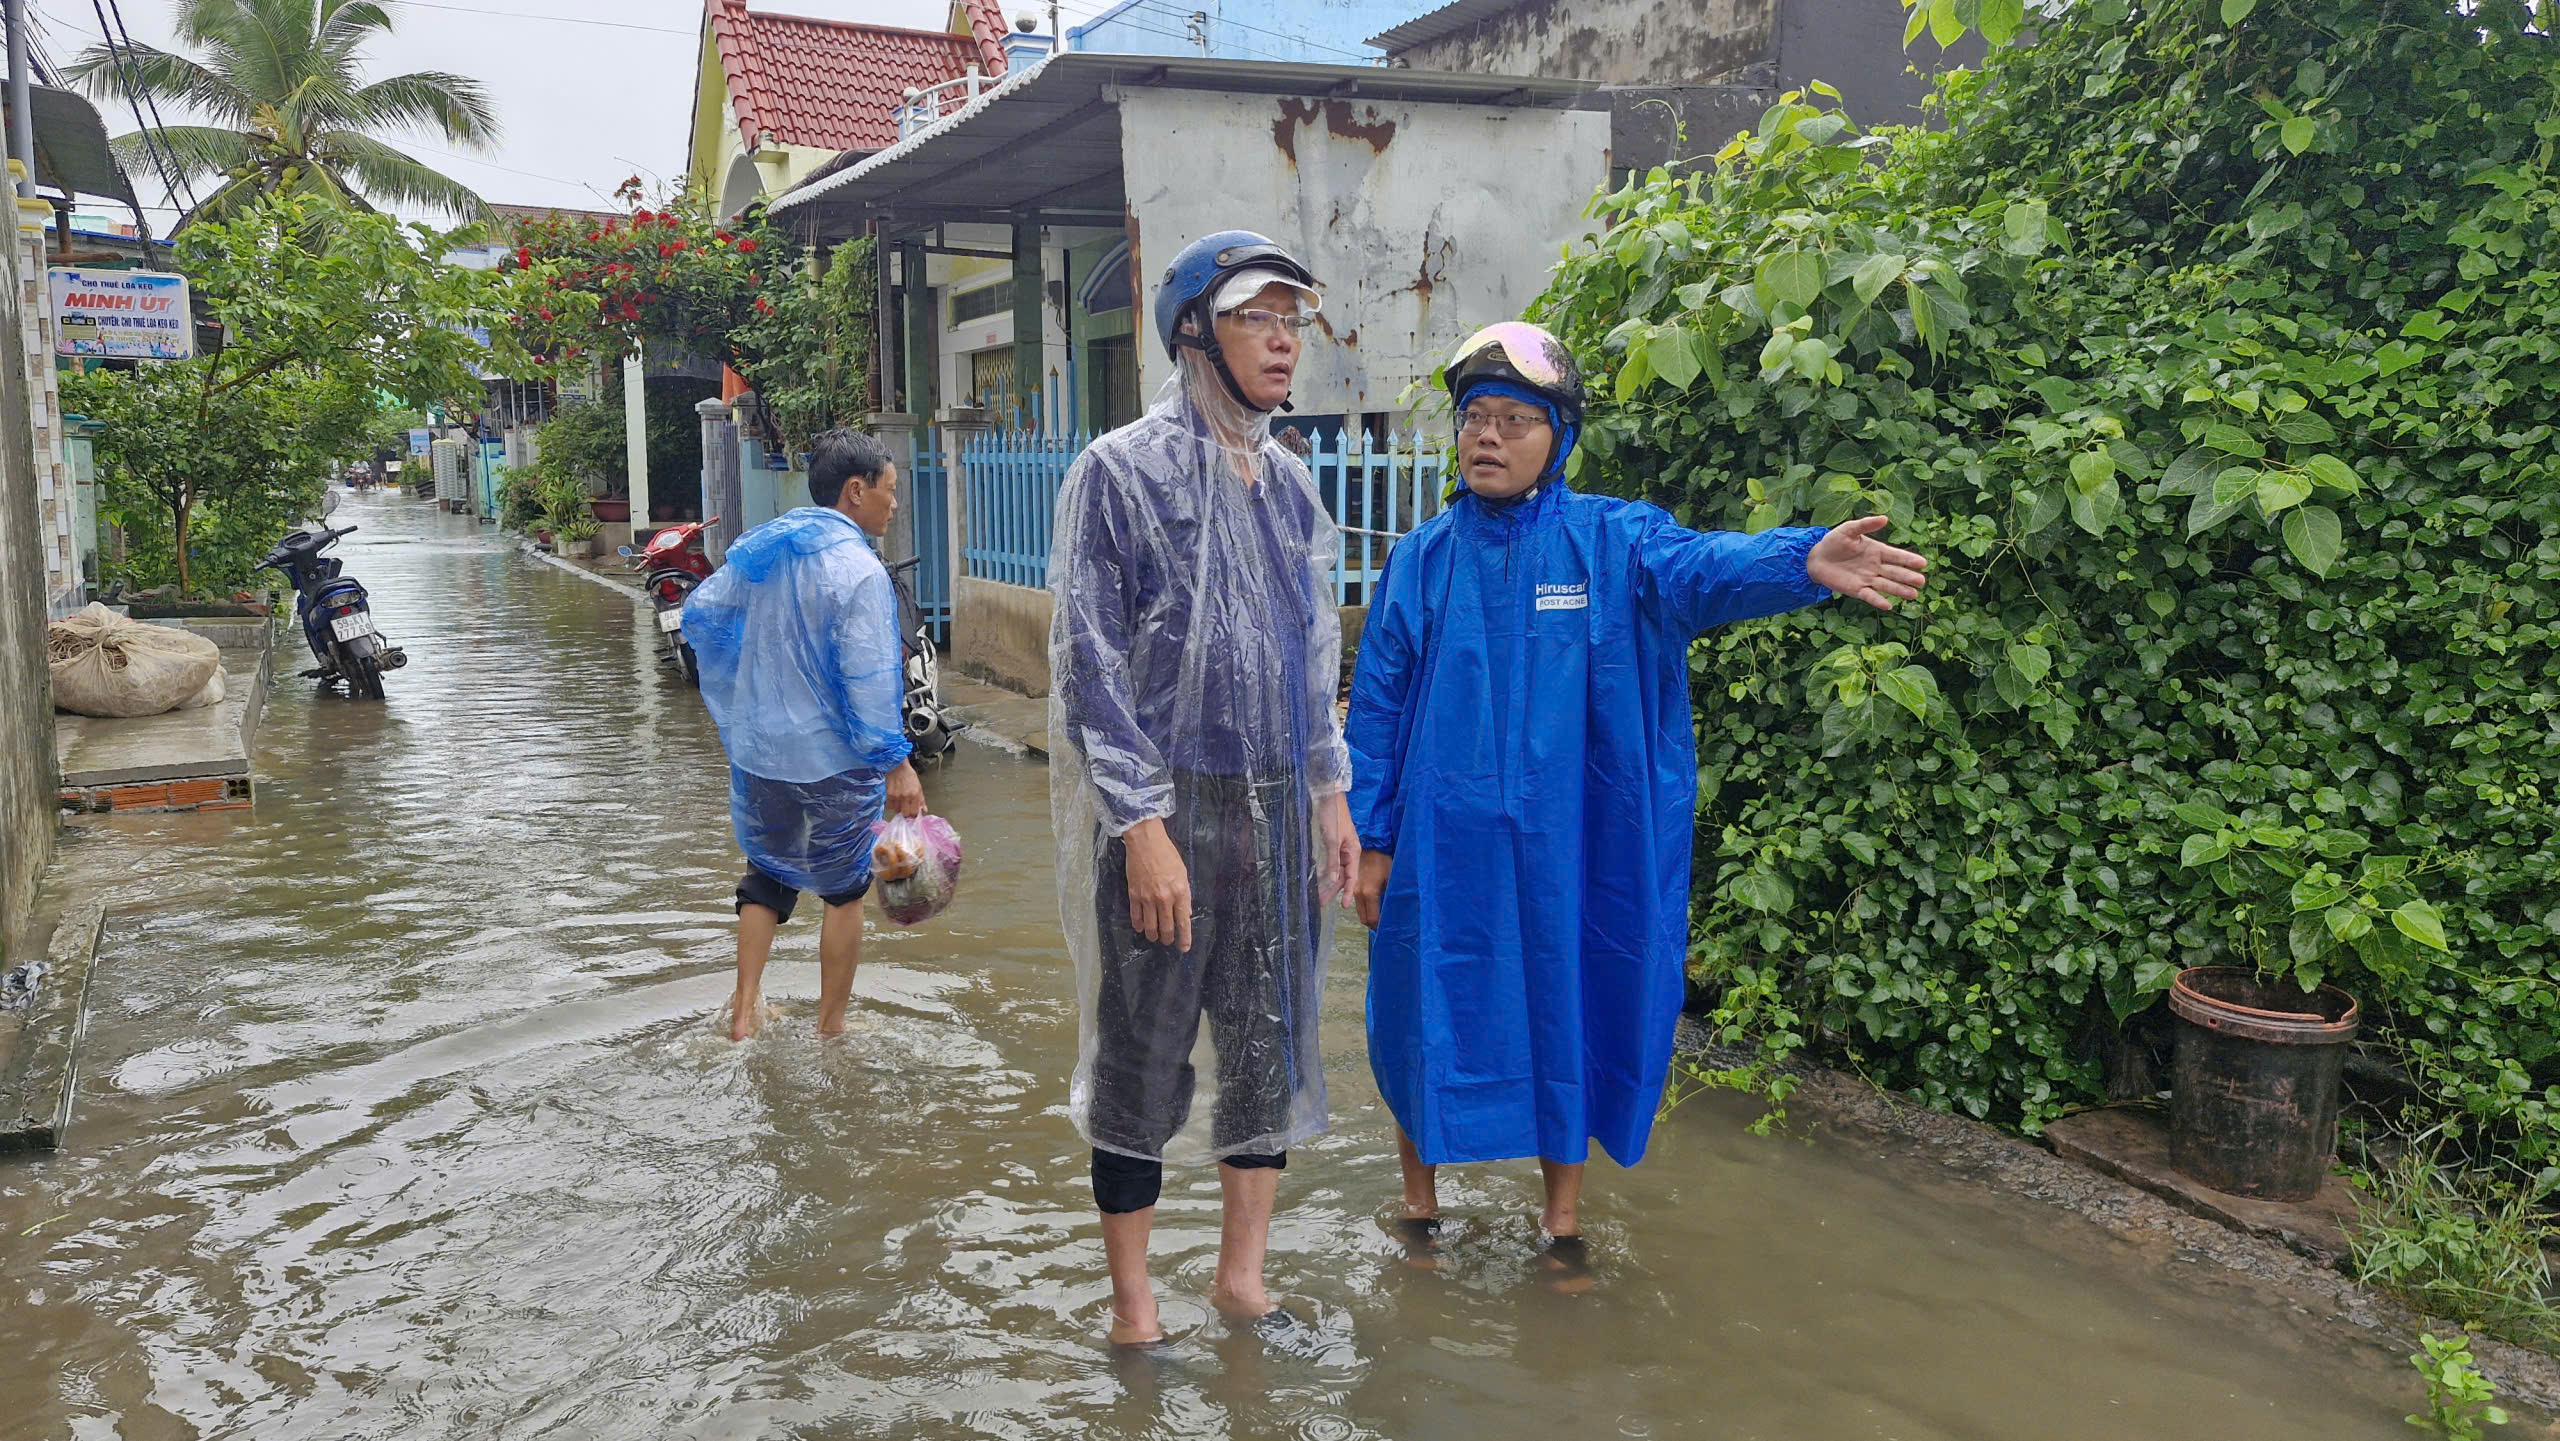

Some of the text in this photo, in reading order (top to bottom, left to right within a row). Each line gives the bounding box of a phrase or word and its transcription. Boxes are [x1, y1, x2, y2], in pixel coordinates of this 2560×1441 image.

[81, 279, 98, 288] CHO
[121, 281, 136, 289] LOA
[140, 292, 172, 312] ÚT
[121, 316, 131, 328] CHO
[147, 317, 157, 328] LOA
[1535, 582, 1586, 596] Hiruscar
[1539, 597, 1586, 607] POST ACNE
